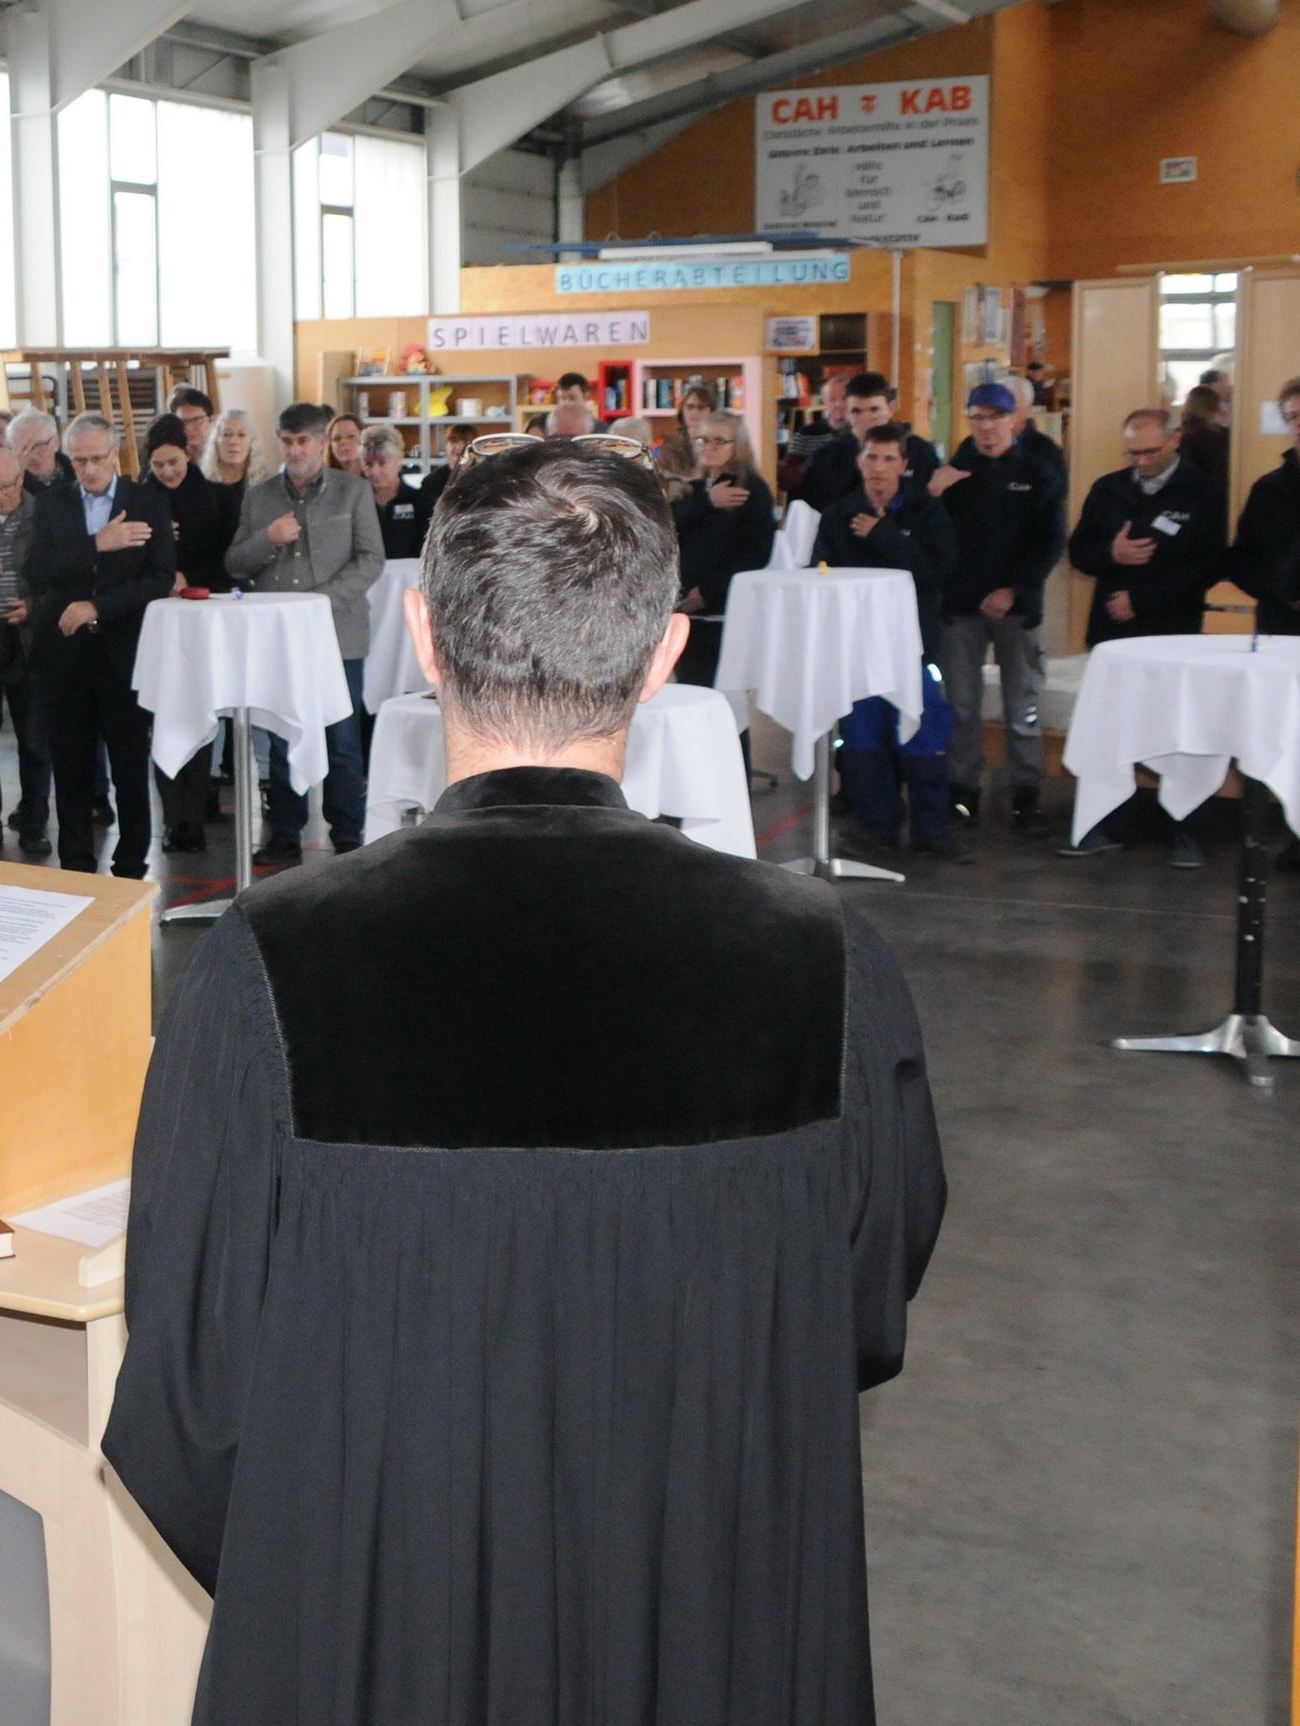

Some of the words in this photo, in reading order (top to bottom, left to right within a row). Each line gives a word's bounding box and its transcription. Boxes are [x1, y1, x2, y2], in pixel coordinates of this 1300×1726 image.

[772, 95, 839, 124] CAH
[900, 85, 973, 114] KAB
[561, 261, 848, 291] BÜCHERABTEILUNG
[434, 320, 647, 348] SPIELWAREN
